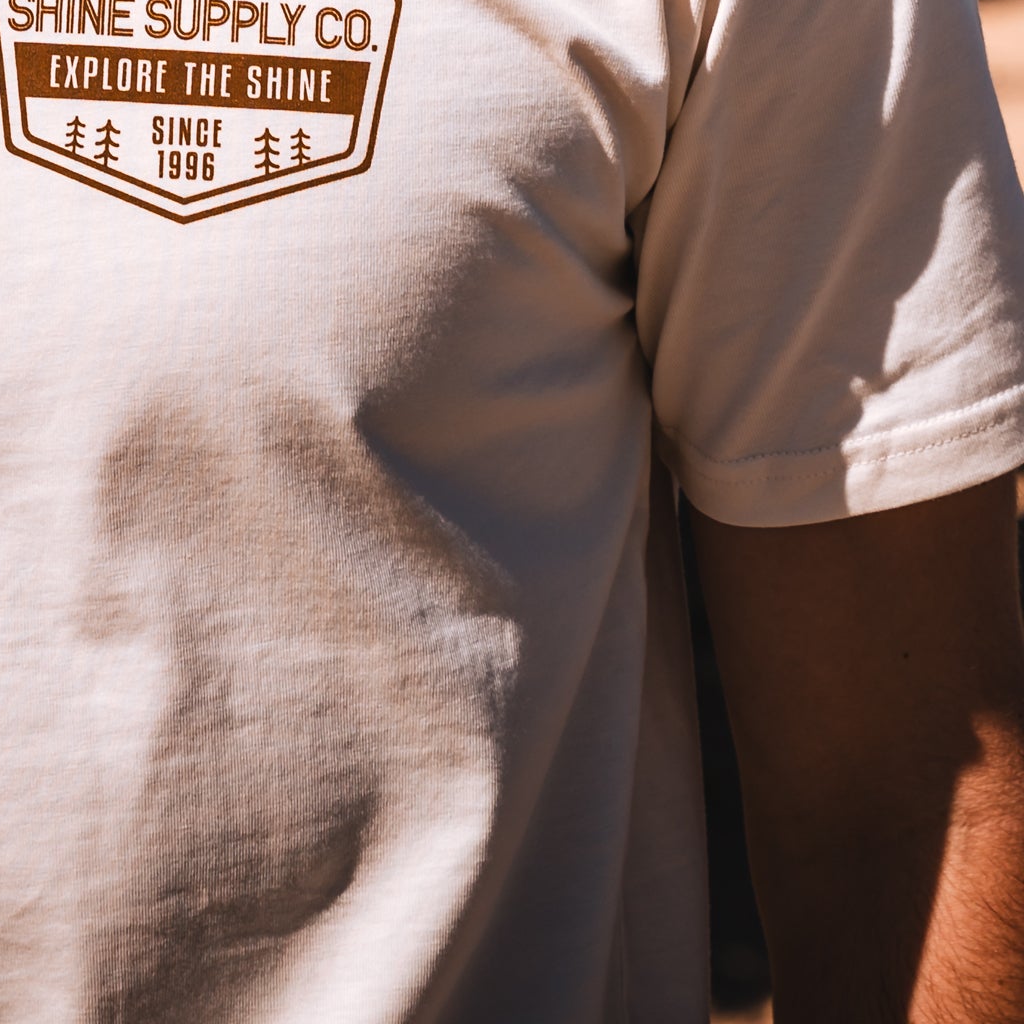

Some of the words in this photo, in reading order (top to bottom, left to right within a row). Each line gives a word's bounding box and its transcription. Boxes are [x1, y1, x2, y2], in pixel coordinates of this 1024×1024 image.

[315, 7, 378, 53] CO.
[49, 55, 168, 94] EXPLORE
[184, 61, 232, 98] THE
[246, 65, 332, 104] SHINE
[152, 116, 223, 149] SINCE
[157, 150, 215, 182] 1996
